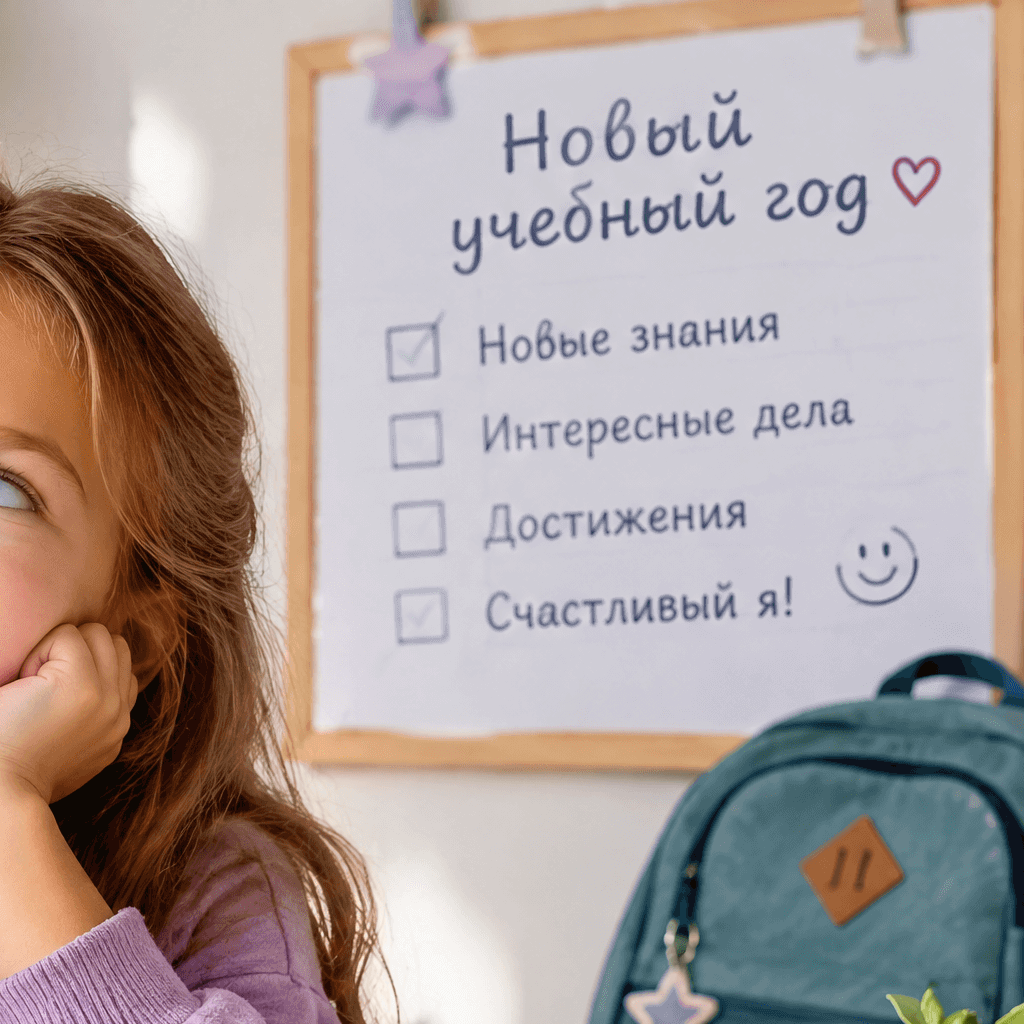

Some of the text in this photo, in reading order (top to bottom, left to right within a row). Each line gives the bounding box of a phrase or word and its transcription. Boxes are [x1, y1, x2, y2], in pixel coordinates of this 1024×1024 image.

[504, 90, 752, 174] Новый
[453, 171, 868, 276] учебный год
[478, 312, 779, 366] Новые знания
[483, 398, 855, 460] Интересные дела
[484, 499, 747, 550] Достижения
[486, 576, 792, 632] Счастливый я!
